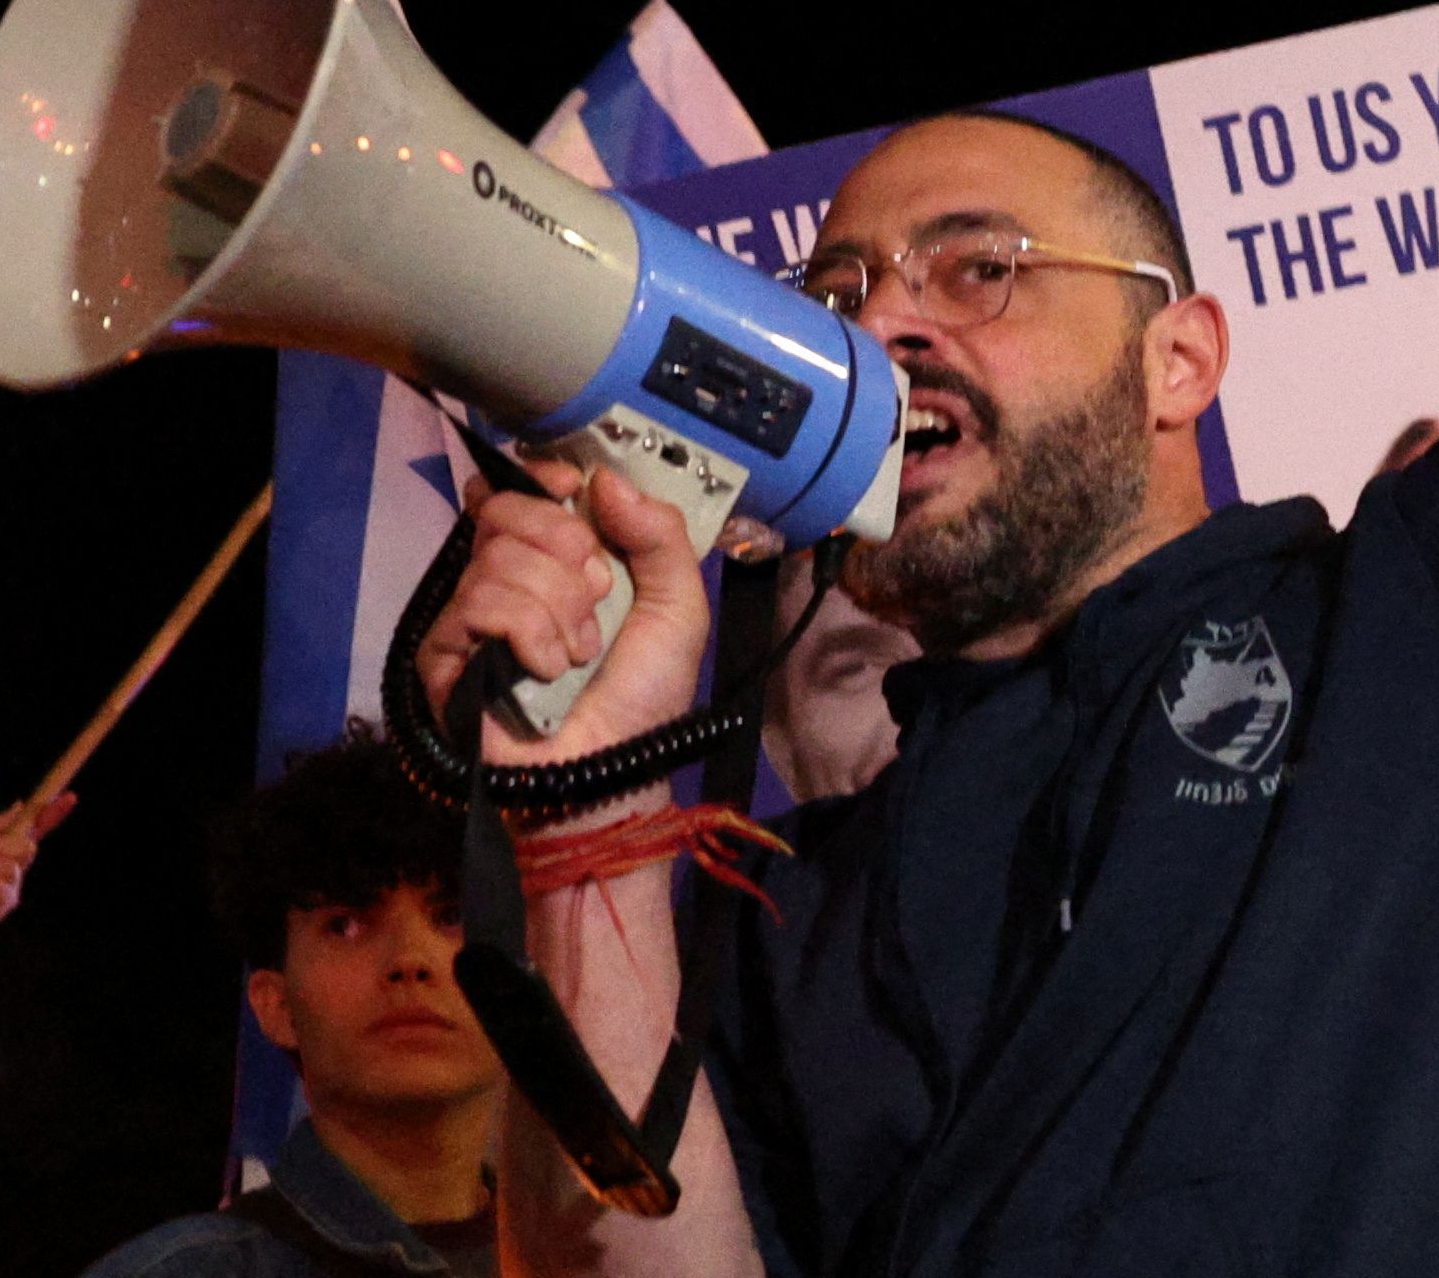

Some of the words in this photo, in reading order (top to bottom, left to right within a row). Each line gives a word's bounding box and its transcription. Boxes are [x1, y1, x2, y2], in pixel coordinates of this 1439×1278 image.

[1203, 105, 1297, 196] TO
[1308, 80, 1402, 174] US
[1226, 205, 1368, 307] THE
